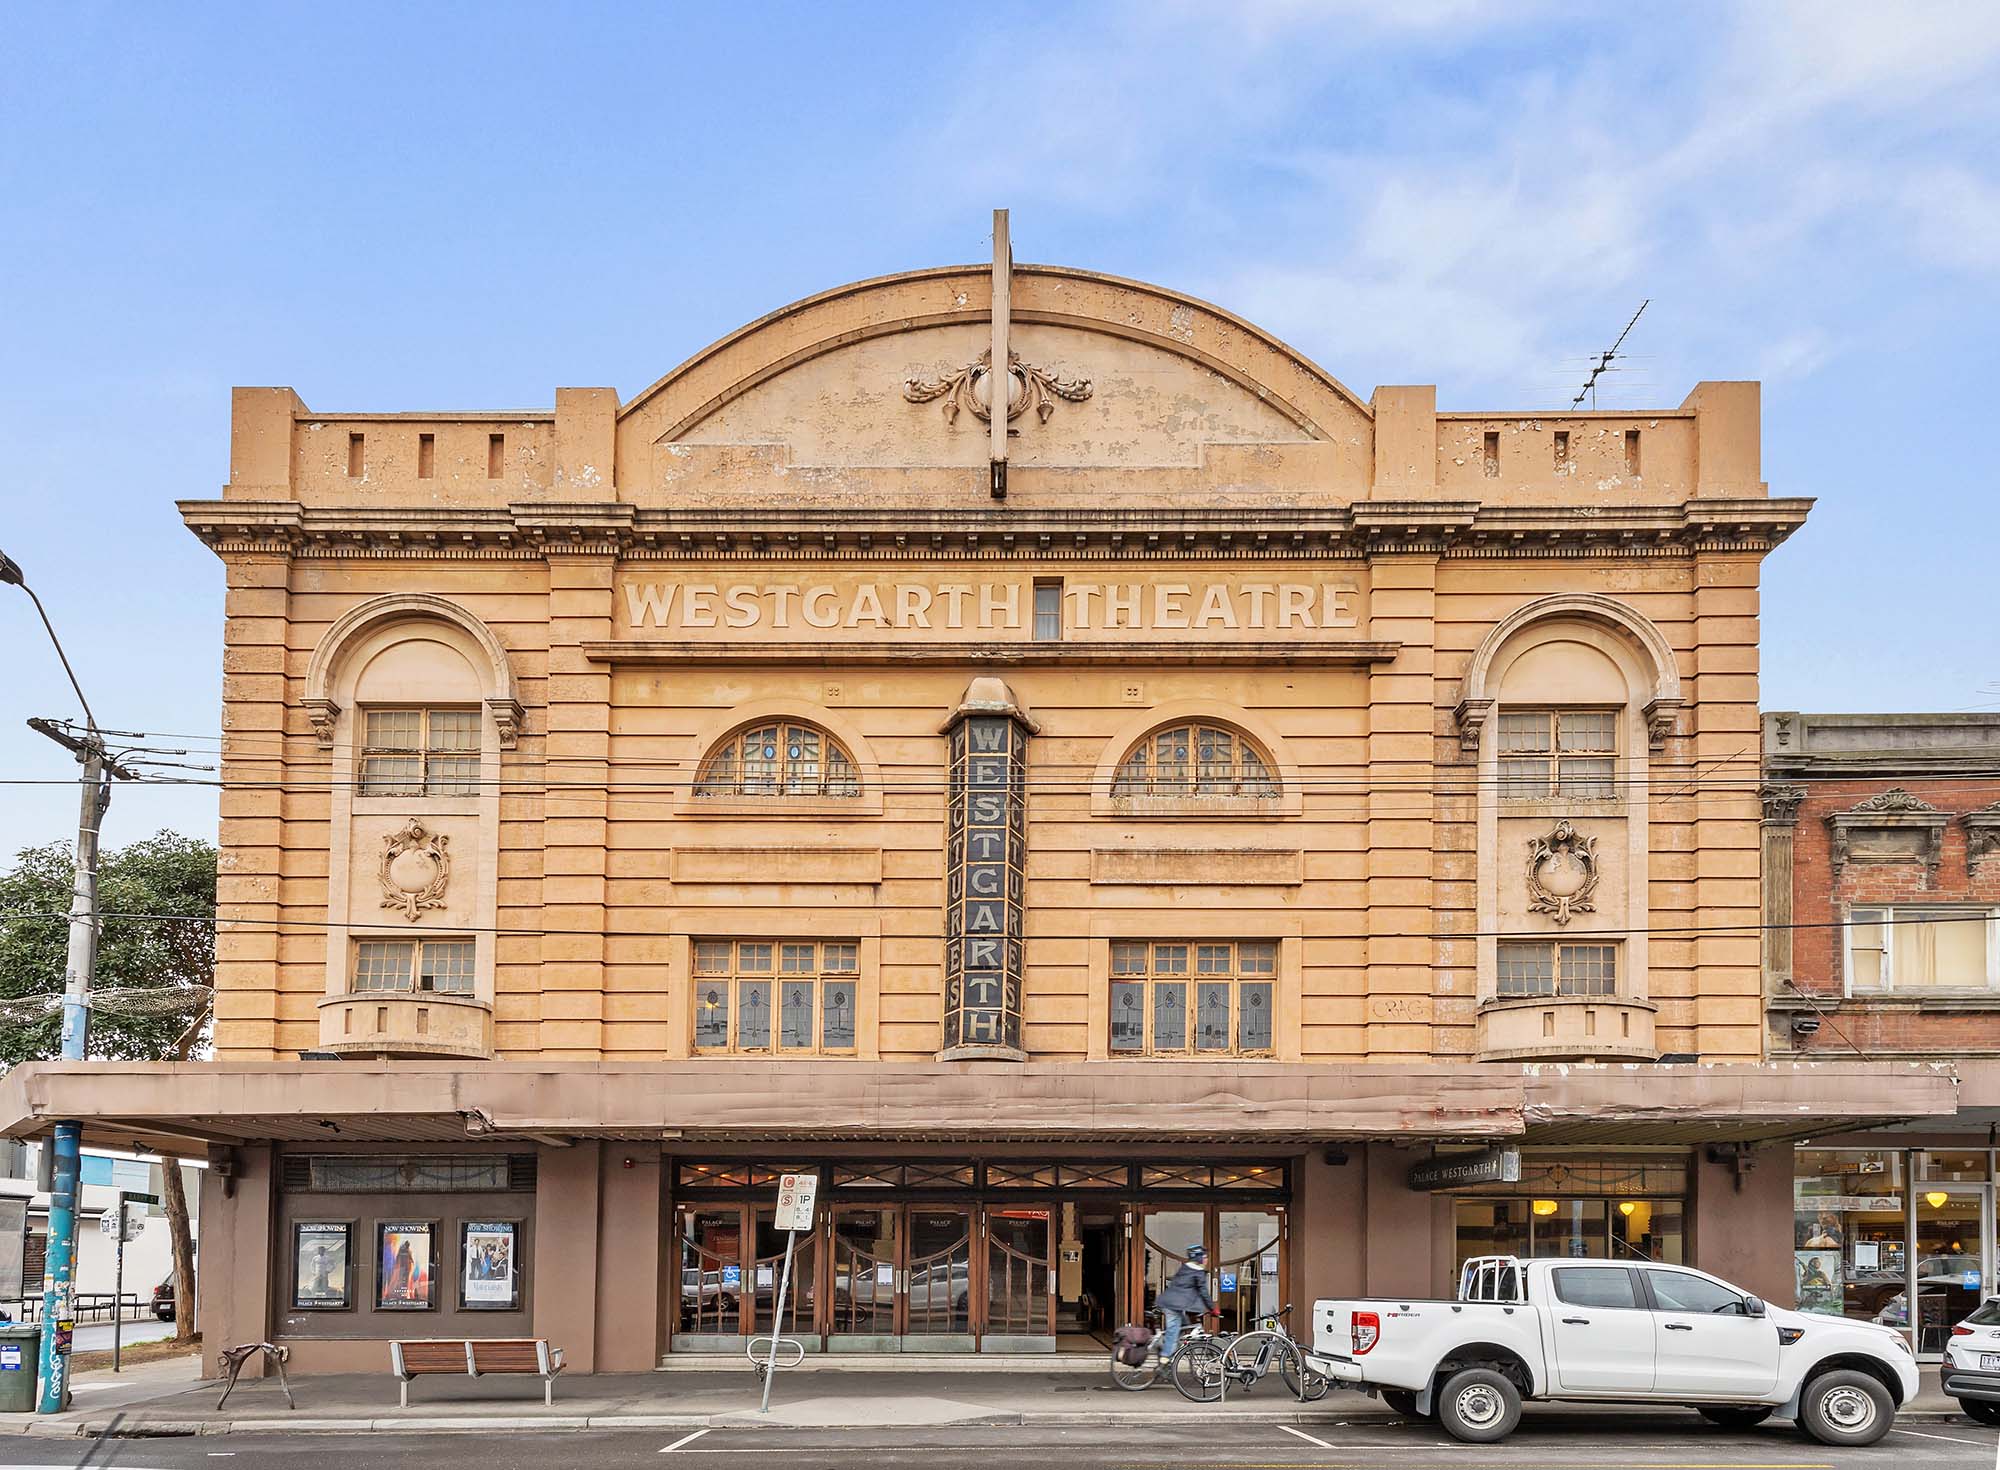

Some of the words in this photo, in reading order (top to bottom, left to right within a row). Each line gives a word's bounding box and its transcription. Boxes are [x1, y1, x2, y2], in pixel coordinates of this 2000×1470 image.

[622, 584, 1022, 629] WESTGARTH
[1063, 584, 1360, 629] THEATRE
[949, 733, 965, 1014] PICTURES
[968, 727, 1004, 1040] WESTGARTH
[1006, 733, 1023, 1014] PICTURES
[1413, 1171, 1438, 1182] PALACE
[1442, 1164, 1491, 1179] WESTGARTH
[800, 1195, 811, 1204] 1P
[467, 1224, 481, 1232] NOW
[482, 1224, 513, 1232] SHOWING
